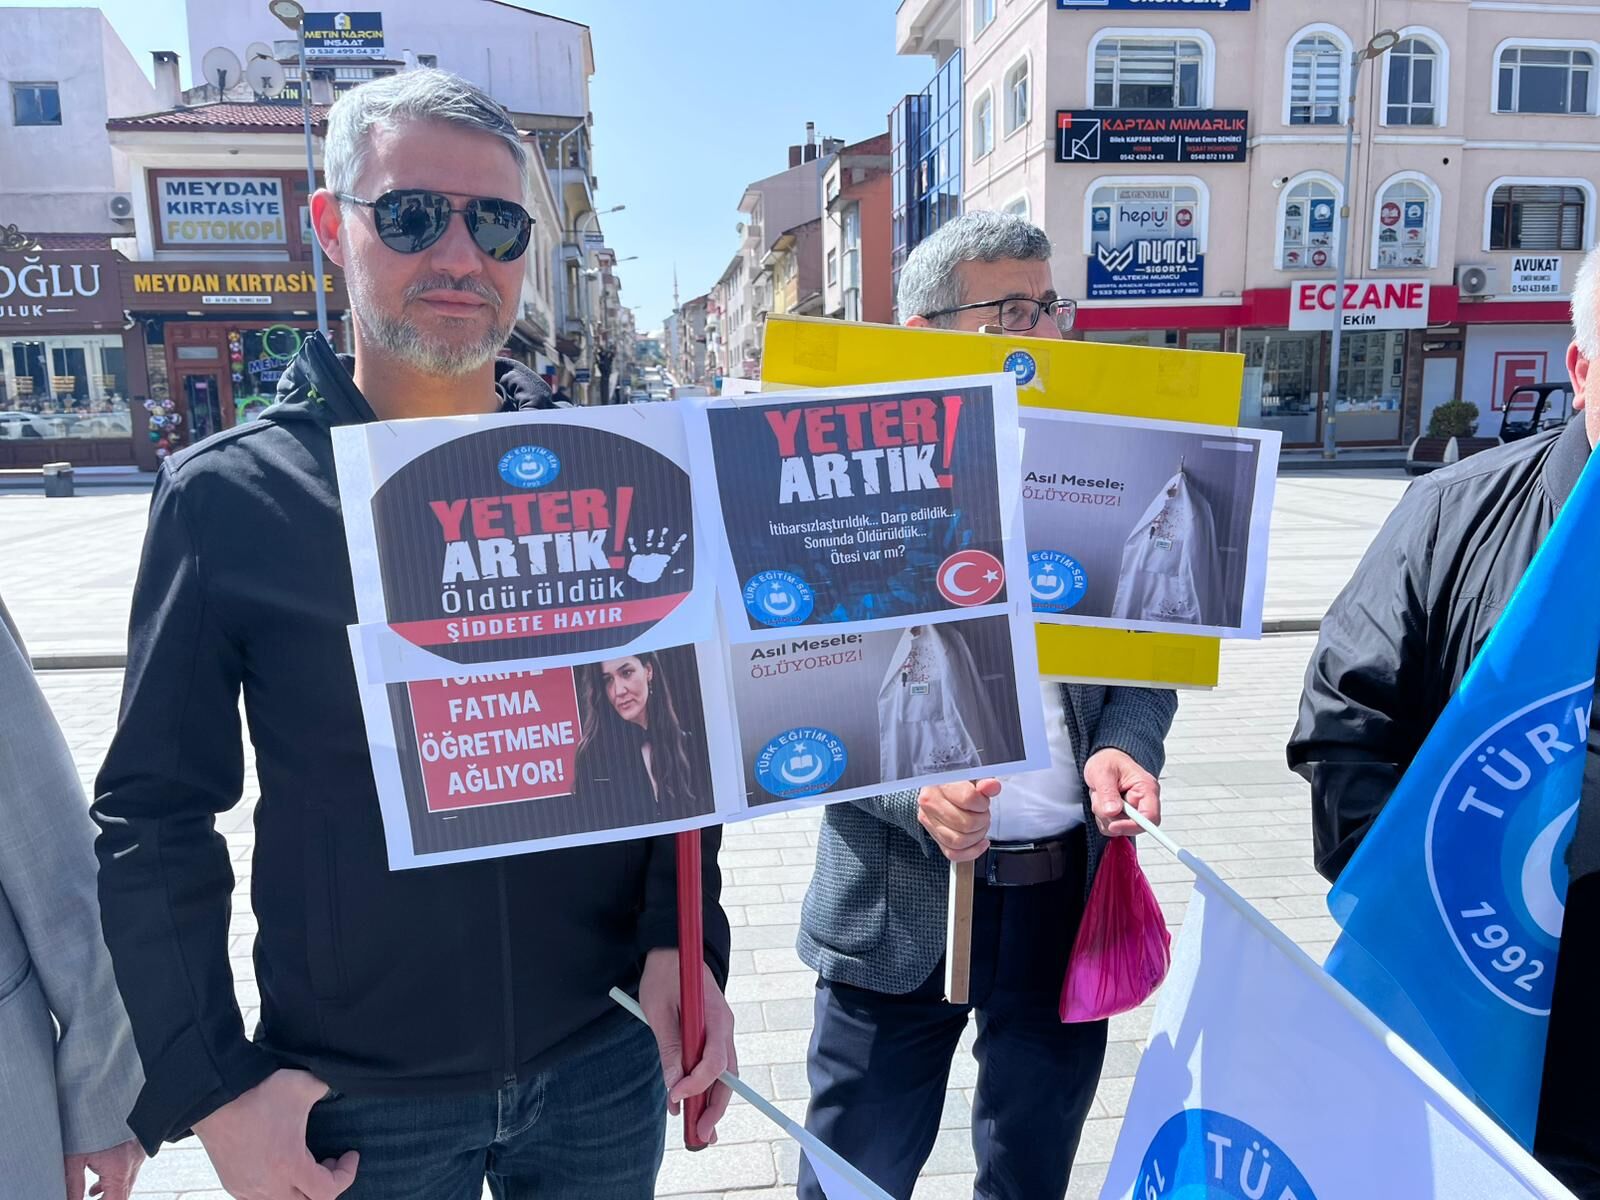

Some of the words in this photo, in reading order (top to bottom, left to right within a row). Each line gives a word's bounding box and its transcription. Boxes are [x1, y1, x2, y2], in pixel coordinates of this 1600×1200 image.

[1102, 119, 1166, 131] KAPTAN
[1169, 118, 1246, 131] MİMARLIK
[166, 182, 277, 196] MEYDAN
[167, 199, 280, 215] KIRTASİYE
[167, 218, 284, 241] FOTOKOPİ
[1514, 258, 1559, 272] AVUKAT
[133, 274, 219, 292] MEYDAN
[225, 270, 334, 292] KIRTASİYE
[1299, 283, 1424, 311] ECZANE
[1343, 313, 1376, 326] EKİM
[1024, 471, 1057, 484] Asıl
[1061, 474, 1125, 491] Mesele;
[1022, 485, 1121, 507] ÖLÜYORUZ!
[769, 514, 879, 536] İtibarsızlaştırıldık...
[881, 511, 908, 525] Darp
[910, 505, 957, 521] edildik...
[804, 532, 854, 549] Sonunda
[856, 525, 927, 544] Öldürüldük...
[830, 549, 861, 565] Ötesi
[862, 549, 881, 561] var
[884, 544, 906, 559] mı?
[441, 576, 625, 614] Öldürüldük
[746, 580, 759, 605] TÜRK
[446, 614, 545, 643] ŞİDDETE
[553, 606, 623, 629] HAYIR
[750, 643, 786, 661] Asıl
[791, 633, 863, 654] Mesele;
[750, 649, 863, 679] ÖLÜYORUZ!
[448, 689, 541, 723] FATMA
[421, 720, 575, 762] ÖĞRETMENE
[757, 744, 778, 776] TÜRK
[778, 729, 843, 761] EĞİTİM-SEN
[448, 758, 565, 795] AĞLIYOR!
[1460, 901, 1545, 992] 1992
